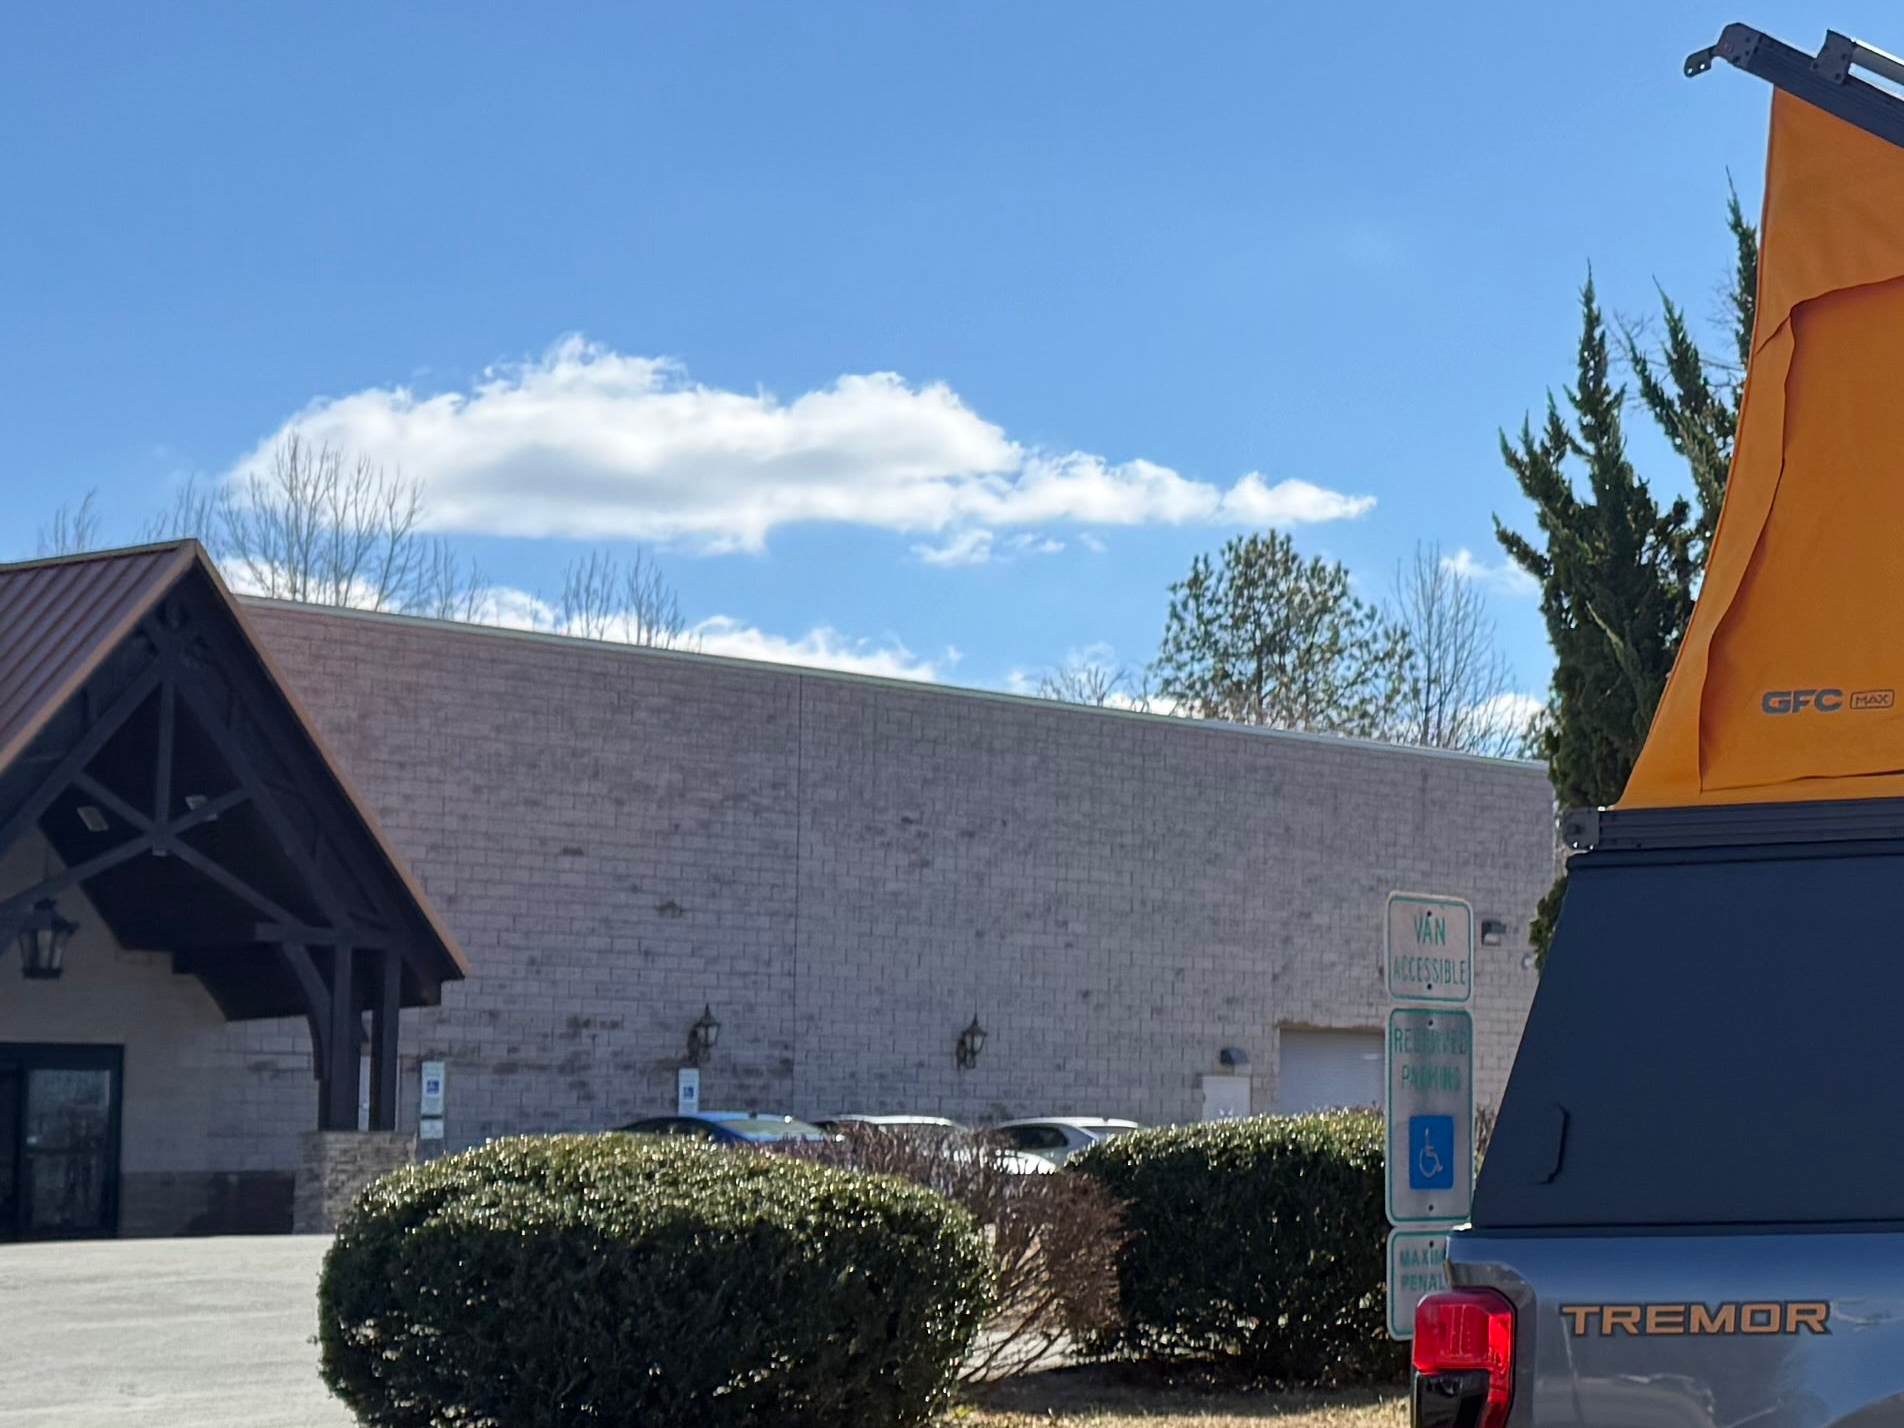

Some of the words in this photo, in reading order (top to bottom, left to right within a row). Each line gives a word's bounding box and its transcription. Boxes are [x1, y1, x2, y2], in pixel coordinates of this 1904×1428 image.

[1762, 688, 1843, 714] GFC
[1855, 693, 1890, 706] MAX
[1413, 915, 1446, 946] VAN
[1393, 956, 1466, 985] ACCESSIBLE
[1401, 1274, 1446, 1291] PENAL
[1559, 1300, 1831, 1336] TREMOR
